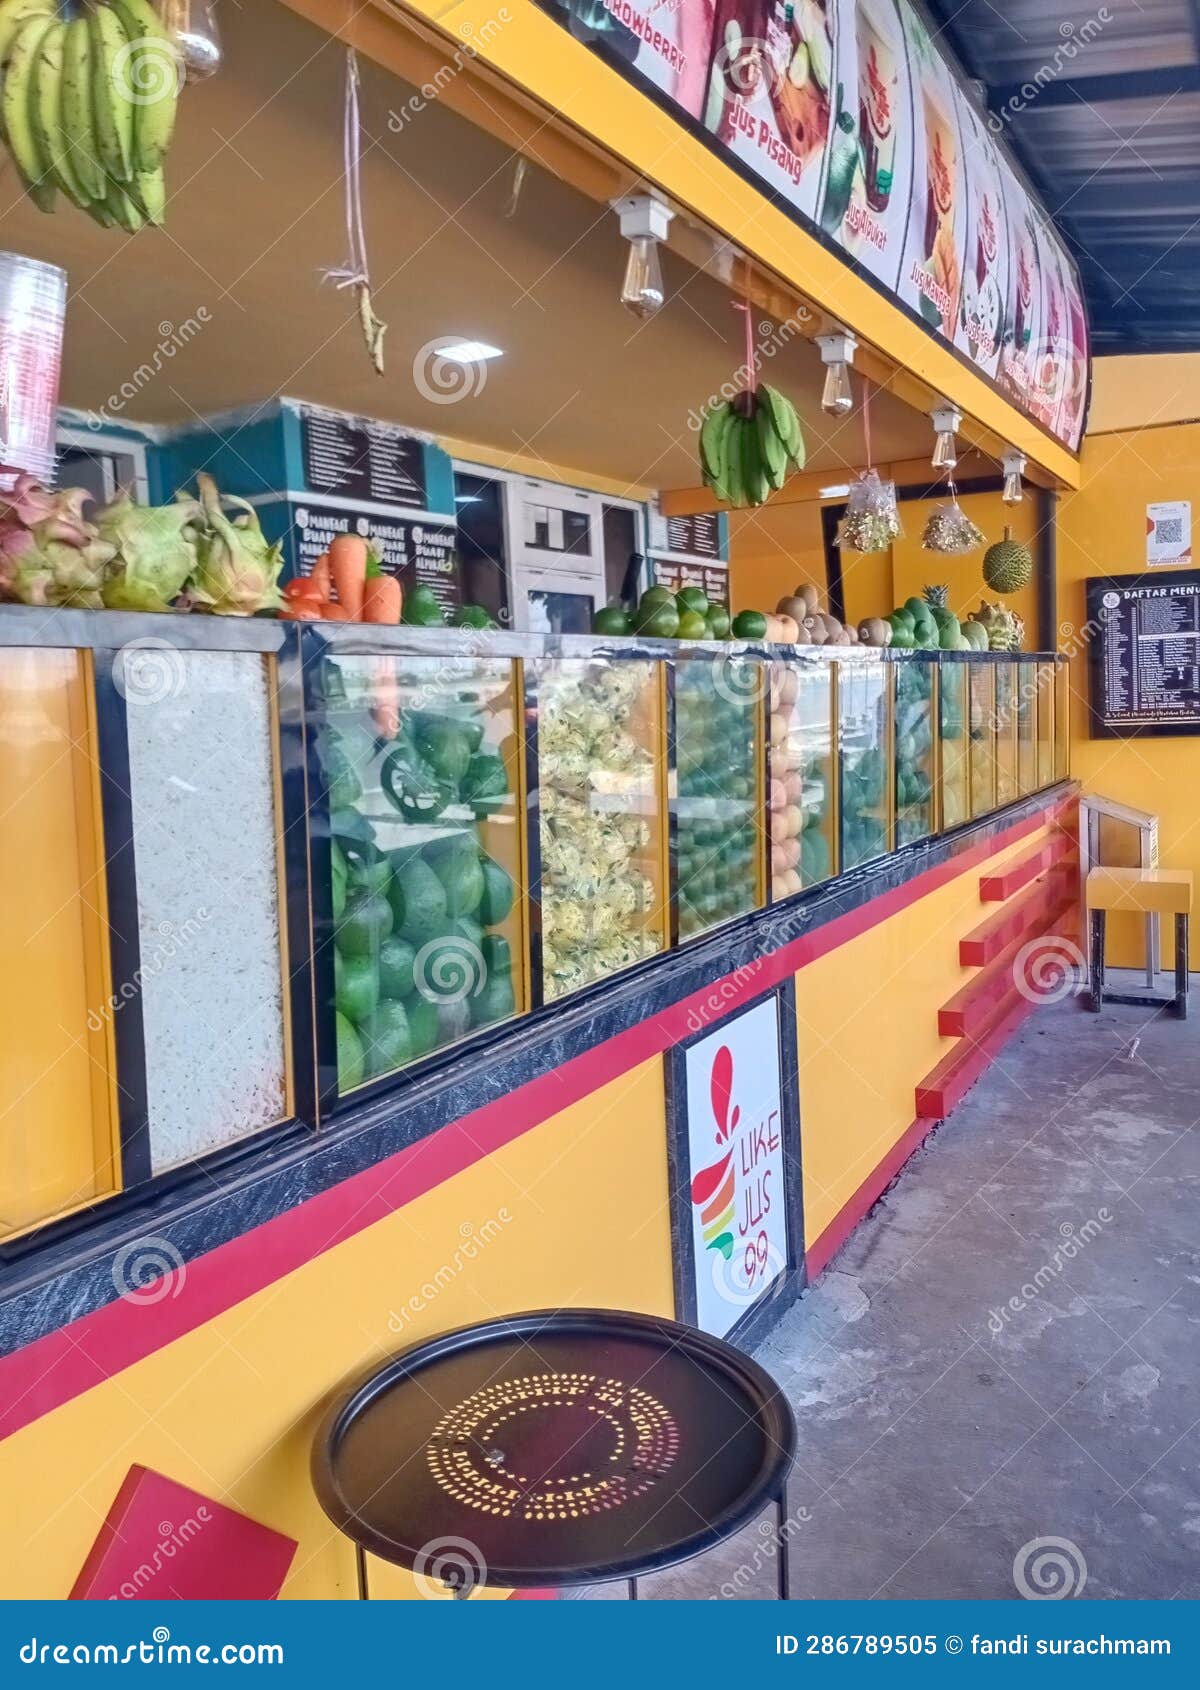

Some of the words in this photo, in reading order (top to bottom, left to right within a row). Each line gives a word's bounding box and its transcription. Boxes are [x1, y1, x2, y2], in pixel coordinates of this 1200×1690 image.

[730, 95, 757, 138] Jus
[1124, 588, 1167, 600] DAFTAR
[740, 1110, 780, 1178] LIKE
[738, 1169, 772, 1237] JUS
[744, 1229, 769, 1290] 99
